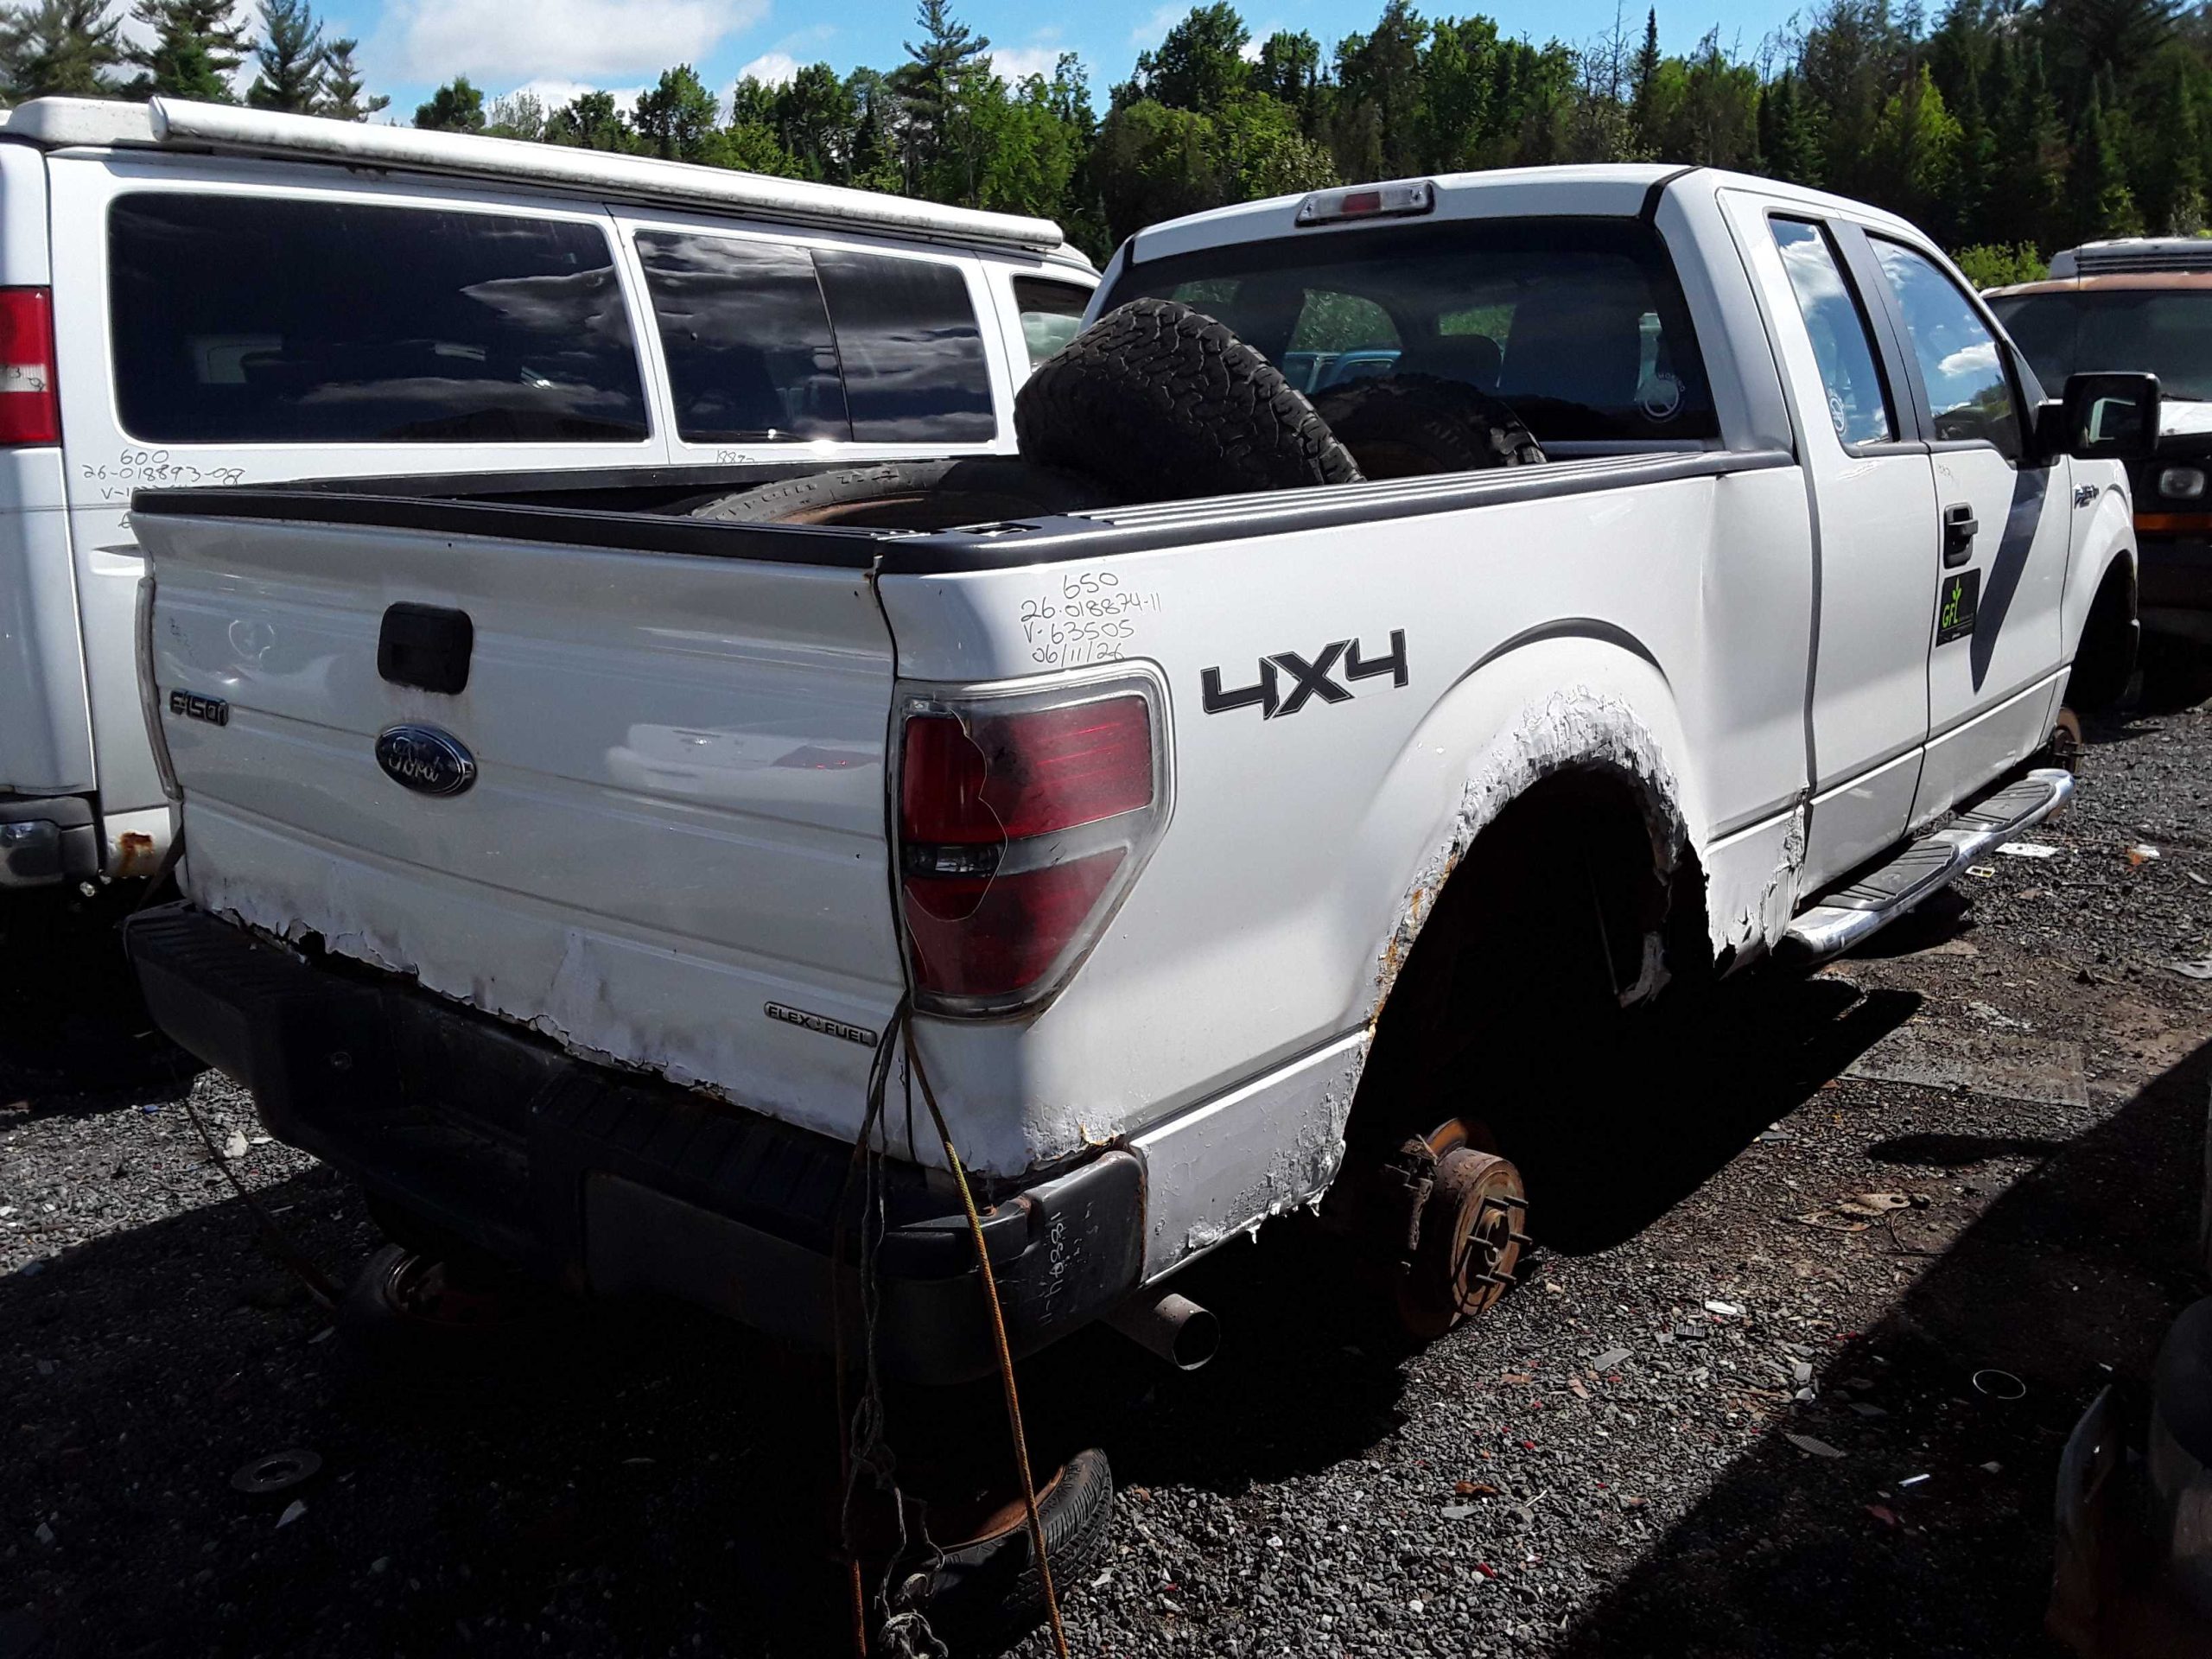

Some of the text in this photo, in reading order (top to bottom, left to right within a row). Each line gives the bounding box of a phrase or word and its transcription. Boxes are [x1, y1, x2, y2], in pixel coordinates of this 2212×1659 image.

[120, 448, 169, 465] 600
[1063, 572, 1119, 600] 650
[1200, 628, 1409, 721] 4X4
[767, 1005, 871, 1045] FLEX FUEL
